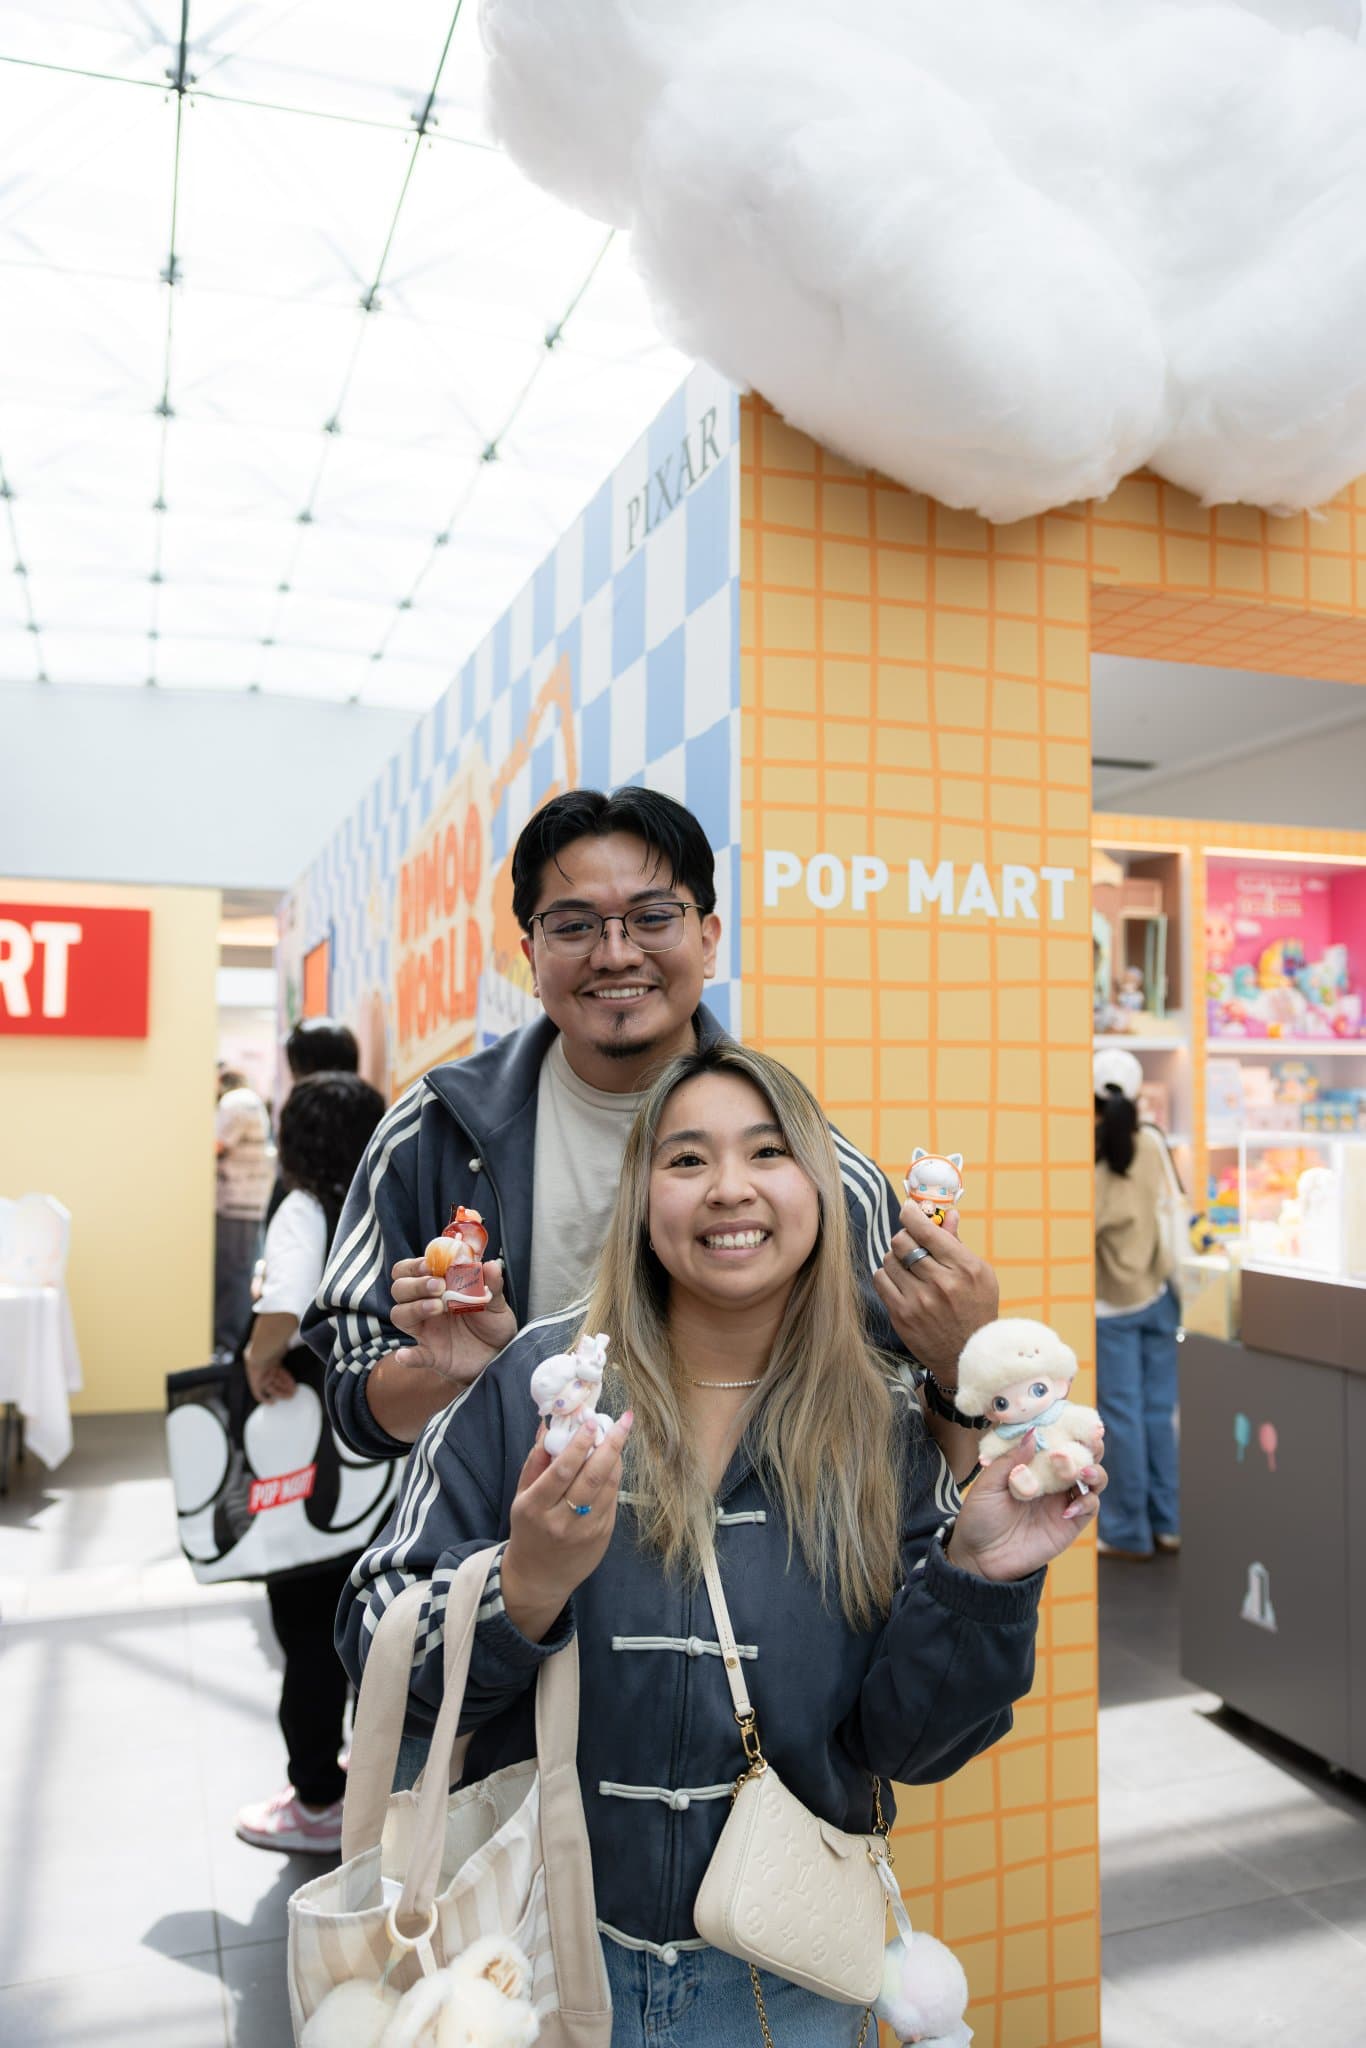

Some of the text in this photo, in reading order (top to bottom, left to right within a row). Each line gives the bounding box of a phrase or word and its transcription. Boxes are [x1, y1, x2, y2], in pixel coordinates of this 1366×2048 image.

[626, 406, 720, 555] PIXAR
[763, 850, 1075, 920] POP MART
[251, 1481, 280, 1508] POP
